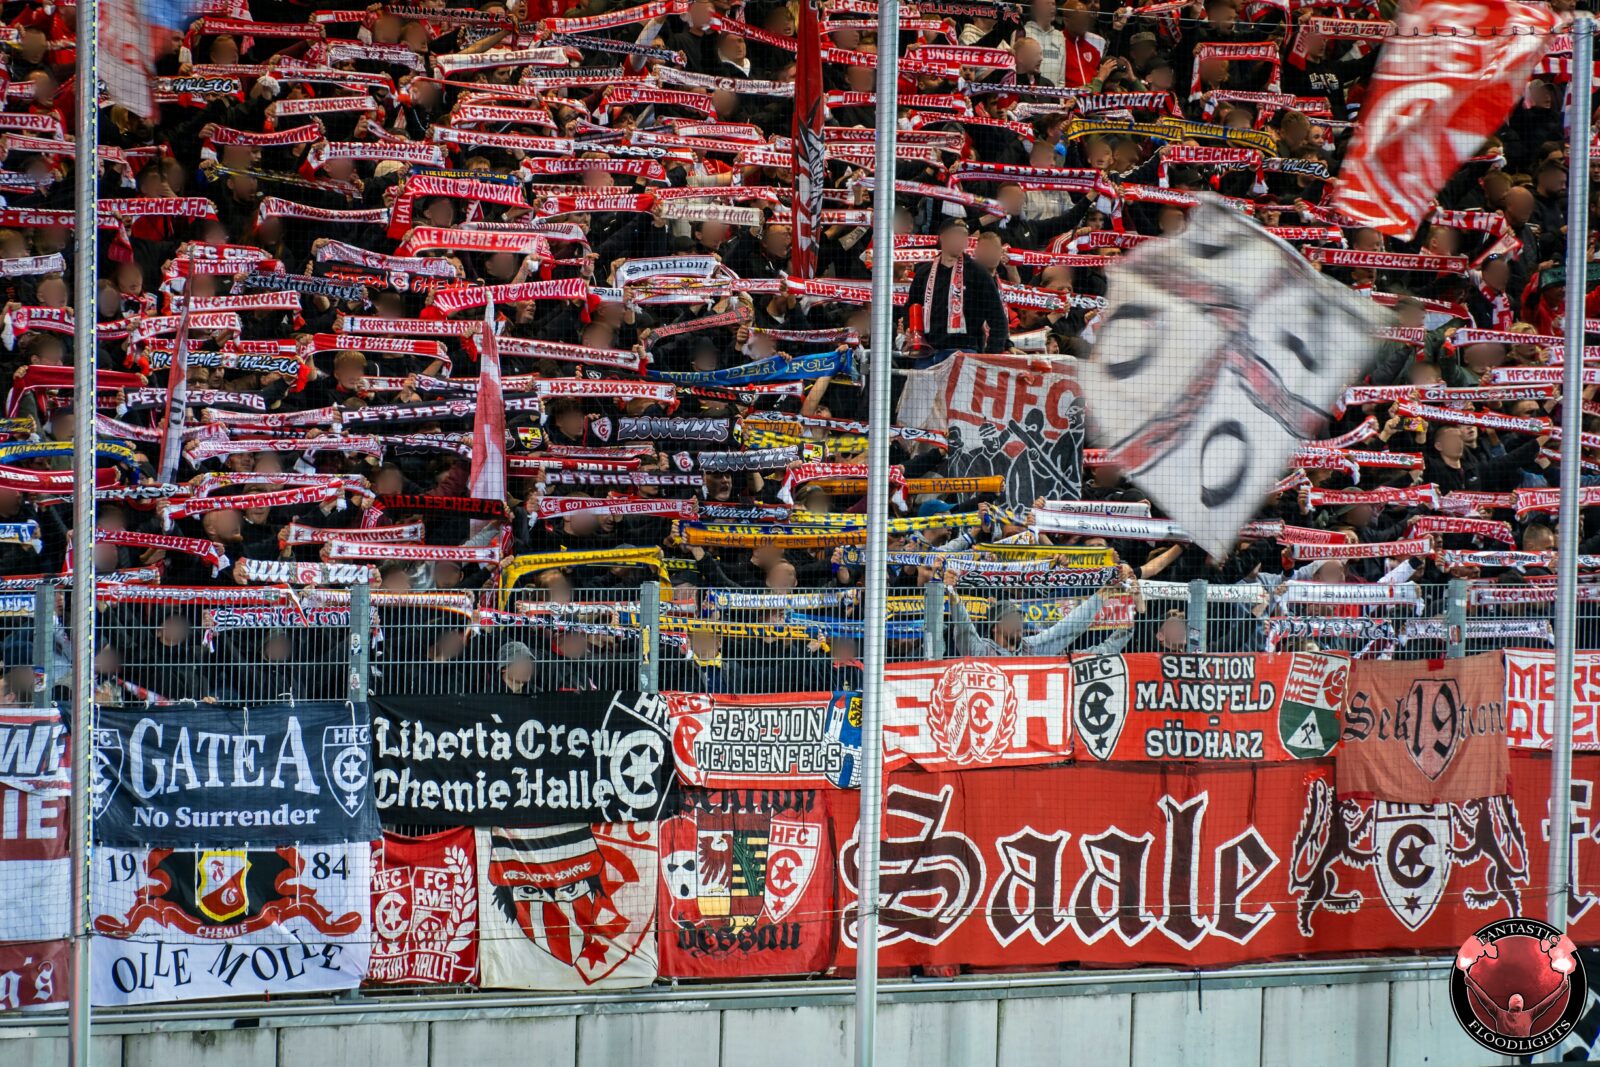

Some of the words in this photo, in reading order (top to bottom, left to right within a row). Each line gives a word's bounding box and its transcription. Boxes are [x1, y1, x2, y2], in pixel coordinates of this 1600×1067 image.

[469, 54, 500, 65] HFC
[503, 49, 557, 62] CHEMIE
[282, 99, 367, 114] HFC-FANKURVE
[696, 126, 753, 137] FUSSBALLCLUB
[456, 133, 556, 151] HFC-FANKURVE
[329, 150, 357, 158] HIER
[360, 150, 399, 159] STEHEN
[1003, 164, 1098, 179] CHEMIE
[575, 195, 597, 210] HFC
[598, 194, 638, 210] CHEMIE
[19, 213, 55, 225] Fans
[666, 203, 705, 220] Erfurt
[722, 208, 754, 222] Halle
[441, 230, 492, 247] UNSERE
[626, 257, 711, 275] Saalefront
[1333, 251, 1419, 268] HALLESCHER
[1423, 258, 1442, 270] FC
[193, 291, 298, 308] HFC-FANKURVE
[727, 360, 778, 379] DER
[786, 356, 836, 374] FCL
[549, 383, 658, 398] HFC-FANKURVE
[971, 366, 1085, 430] HFC
[931, 477, 981, 493] MACHT
[383, 495, 482, 513] HALLESCHER
[484, 500, 502, 515] FC
[608, 505, 625, 515] EIN
[625, 503, 654, 513] LEBEN
[655, 502, 678, 511] LANG
[1061, 502, 1130, 517] Saalefront
[357, 546, 478, 561] HFC-FANKURVE
[1299, 541, 1425, 559] KURT-WABBEL-STADION
[1074, 656, 1114, 685] HFC
[1161, 656, 1256, 680] SEKTION
[966, 673, 998, 690] HFC
[1136, 682, 1276, 712] MANSFELD
[711, 707, 826, 742] SEKTION
[334, 728, 372, 745] HFC
[373, 712, 513, 761] Libertà
[515, 719, 622, 760] Crew
[1144, 718, 1264, 759] SÜDHARZ
[129, 715, 267, 800] GATE
[270, 714, 321, 795] A
[693, 742, 842, 773] WEISSENFELS
[373, 766, 512, 813] Chemie
[511, 765, 616, 812] Halle
[133, 806, 171, 829] No
[174, 804, 321, 829] Surrender
[770, 826, 809, 846] HFC
[106, 851, 138, 883] 19
[311, 850, 350, 881] 84
[839, 784, 1282, 952] Saale
[423, 869, 449, 890] FC
[415, 889, 455, 909] RWE
[196, 924, 249, 939] CHEMIE
[111, 940, 193, 995] OLLE
